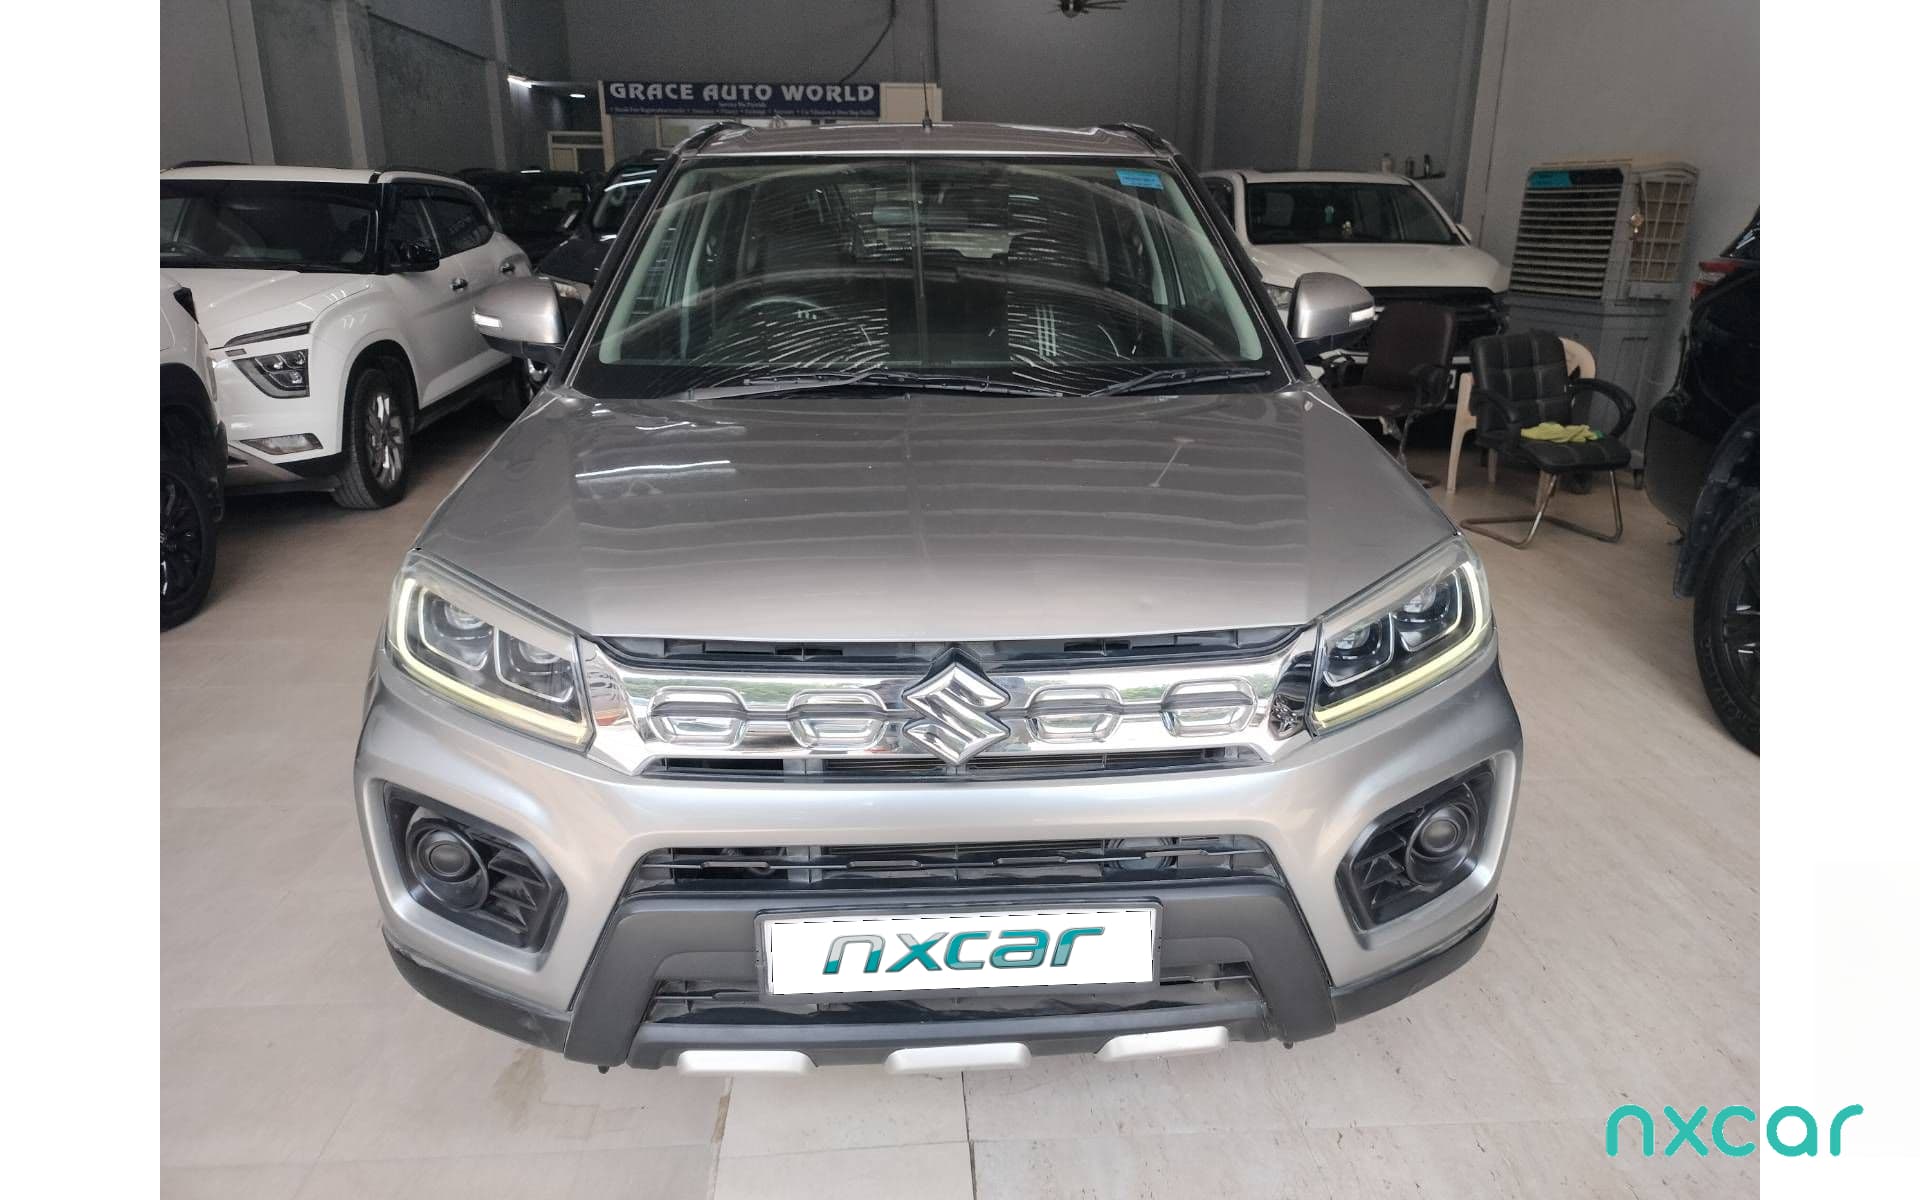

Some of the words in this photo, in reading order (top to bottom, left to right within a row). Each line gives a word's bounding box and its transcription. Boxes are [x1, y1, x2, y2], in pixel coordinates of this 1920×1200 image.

[609, 83, 694, 101] GRACE
[703, 84, 772, 102] AUTO
[781, 85, 875, 103] WORLD
